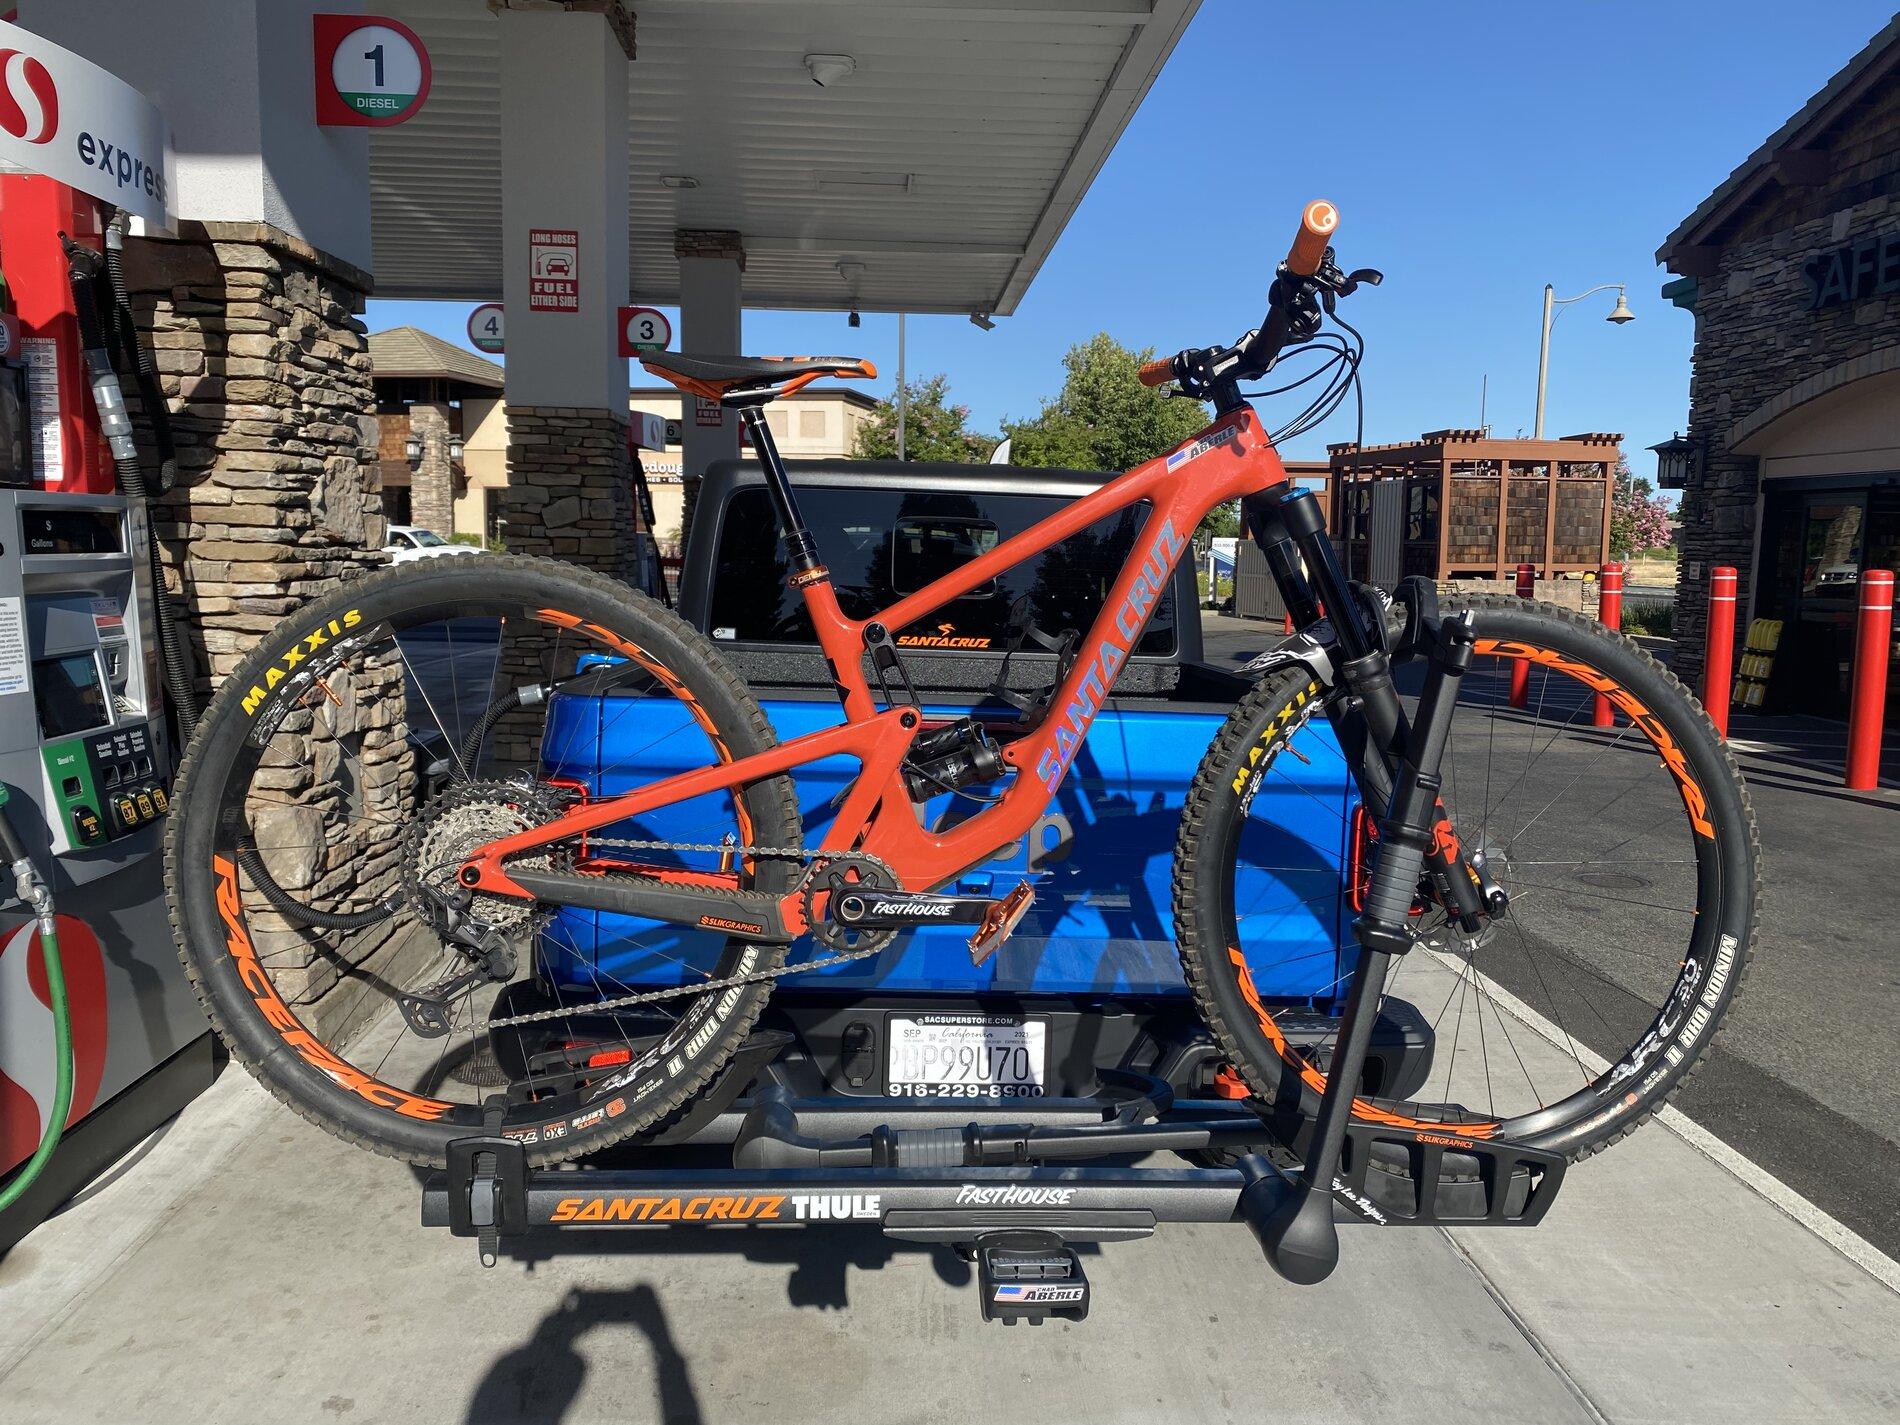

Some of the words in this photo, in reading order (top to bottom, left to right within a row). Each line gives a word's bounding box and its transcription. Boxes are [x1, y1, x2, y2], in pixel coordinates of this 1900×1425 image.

[364, 44, 385, 87] 1
[356, 97, 400, 110] DIESEL
[531, 233, 551, 244] LONG
[551, 233, 576, 245] HOSES
[534, 282, 574, 294] FUEL
[530, 294, 558, 307] EITHER
[559, 295, 578, 307] SIDE
[484, 316, 499, 336] 4
[640, 320, 655, 340] 3
[20, 337, 57, 345] WARNING
[666, 425, 675, 437] 6
[31, 538, 53, 549] Gallons
[896, 635, 991, 649] SANTACRUZ
[240, 608, 362, 717] MAXXIS
[1036, 639, 1126, 795] SANTA
[1116, 517, 1186, 645] CRUZ
[123, 807, 133, 818] 87
[140, 801, 151, 812] 89
[872, 901, 955, 916] FASTHOUSE
[708, 917, 762, 934] SLIKGRAPHICS
[1700, 933, 1738, 1009] MINION
[924, 1016, 1013, 1025] SACSUPERSTORE.COM
[1678, 1004, 1712, 1049] DHR
[684, 1015, 720, 1060] DHR
[903, 1029, 922, 1038] SEP
[941, 1027, 994, 1043] California
[543, 1126, 566, 1140] EXO
[1423, 1135, 1474, 1149] SLIKGRAPHICS
[955, 1184, 1077, 1206] FASTHOUSE
[549, 1194, 788, 1222] SANTACRUZ
[791, 1194, 881, 1220] THULE
[1023, 1290, 1082, 1301] ABERLE
